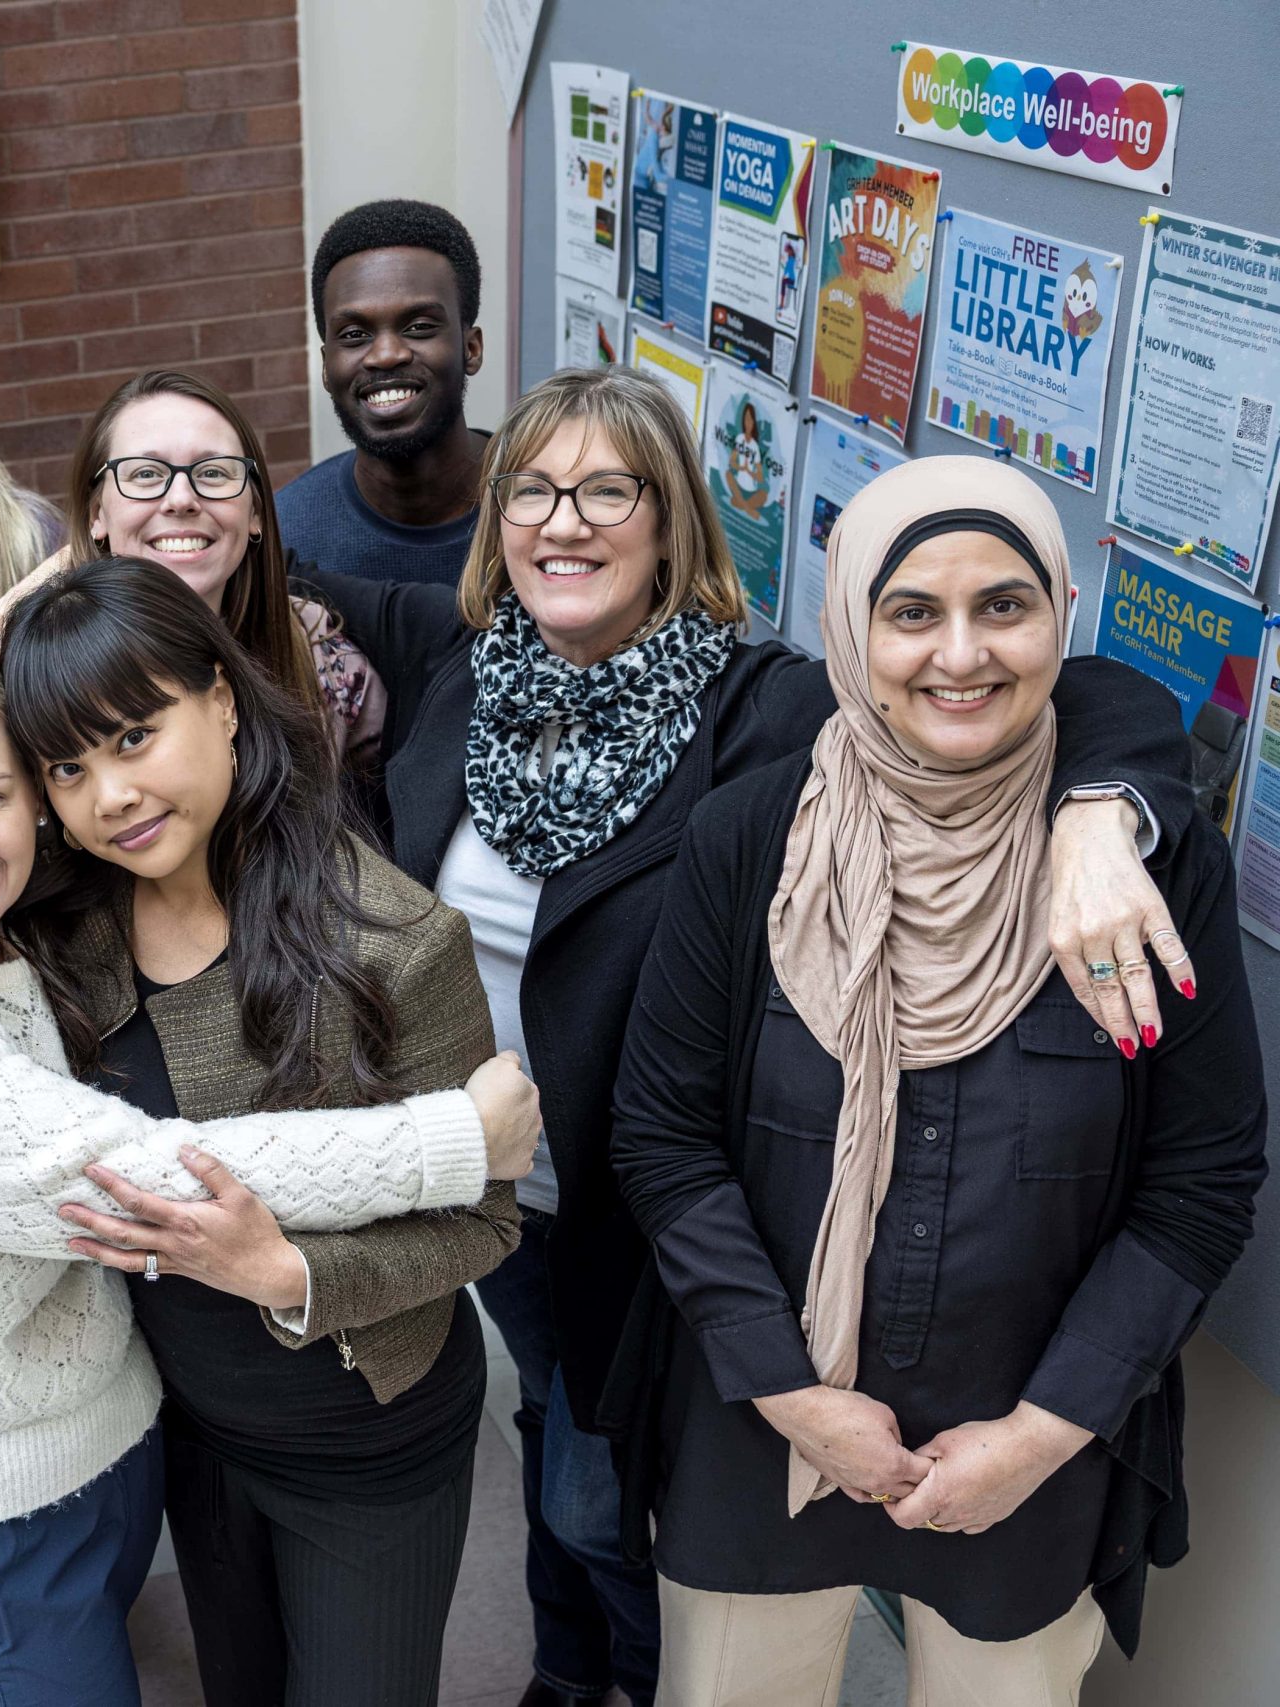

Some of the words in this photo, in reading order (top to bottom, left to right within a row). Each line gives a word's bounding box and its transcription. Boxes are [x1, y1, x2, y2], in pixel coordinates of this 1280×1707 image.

[912, 71, 1016, 121] Workplace
[1023, 91, 1152, 155] Well-being
[727, 131, 776, 158] MOMENTUM
[726, 149, 774, 190] YOGA
[724, 178, 737, 195] ON
[739, 182, 773, 206] DEMAND
[847, 177, 860, 191] GRH
[862, 177, 881, 193] TEAM
[883, 182, 914, 211] MEMBER
[829, 195, 867, 243] ART
[871, 197, 930, 271] DAYS
[958, 235, 977, 251] Come
[978, 242, 991, 255] visit
[991, 245, 1011, 261] GRH's
[1012, 235, 1059, 272] FREE
[1160, 235, 1200, 261] WINTER
[1202, 246, 1266, 279] SCAVENGER
[828, 286, 843, 306] JOIN
[955, 248, 1057, 320] LITTLE
[1186, 265, 1210, 279] JANUARY
[1220, 275, 1244, 291] February
[1252, 284, 1267, 295] 2025
[1167, 293, 1188, 307] January
[1200, 303, 1223, 319] February
[951, 291, 1092, 377] LIBRARY
[948, 339, 995, 367] Take-a-Book
[1014, 364, 1068, 395] Leave-a-Book
[1142, 362, 1150, 373] 1.
[1144, 334, 1169, 355] HOW
[1170, 343, 1179, 358] IT
[1181, 346, 1216, 372] WORKS:
[971, 384, 984, 397] 24/7
[1001, 398, 1015, 410] room
[1022, 404, 1031, 416] not
[974, 374, 991, 388] Space
[1011, 388, 1021, 399] the
[1138, 389, 1146, 401] 2.
[715, 425, 757, 464] Workday
[760, 448, 783, 477] Yoga
[1129, 452, 1137, 464] 3.
[1118, 569, 1232, 647] MASSAGE
[1114, 599, 1182, 656] CHAIR
[1110, 627, 1123, 641] For
[1124, 635, 1141, 652] GRH
[1143, 644, 1164, 665] Team
[1166, 656, 1206, 686] Members
